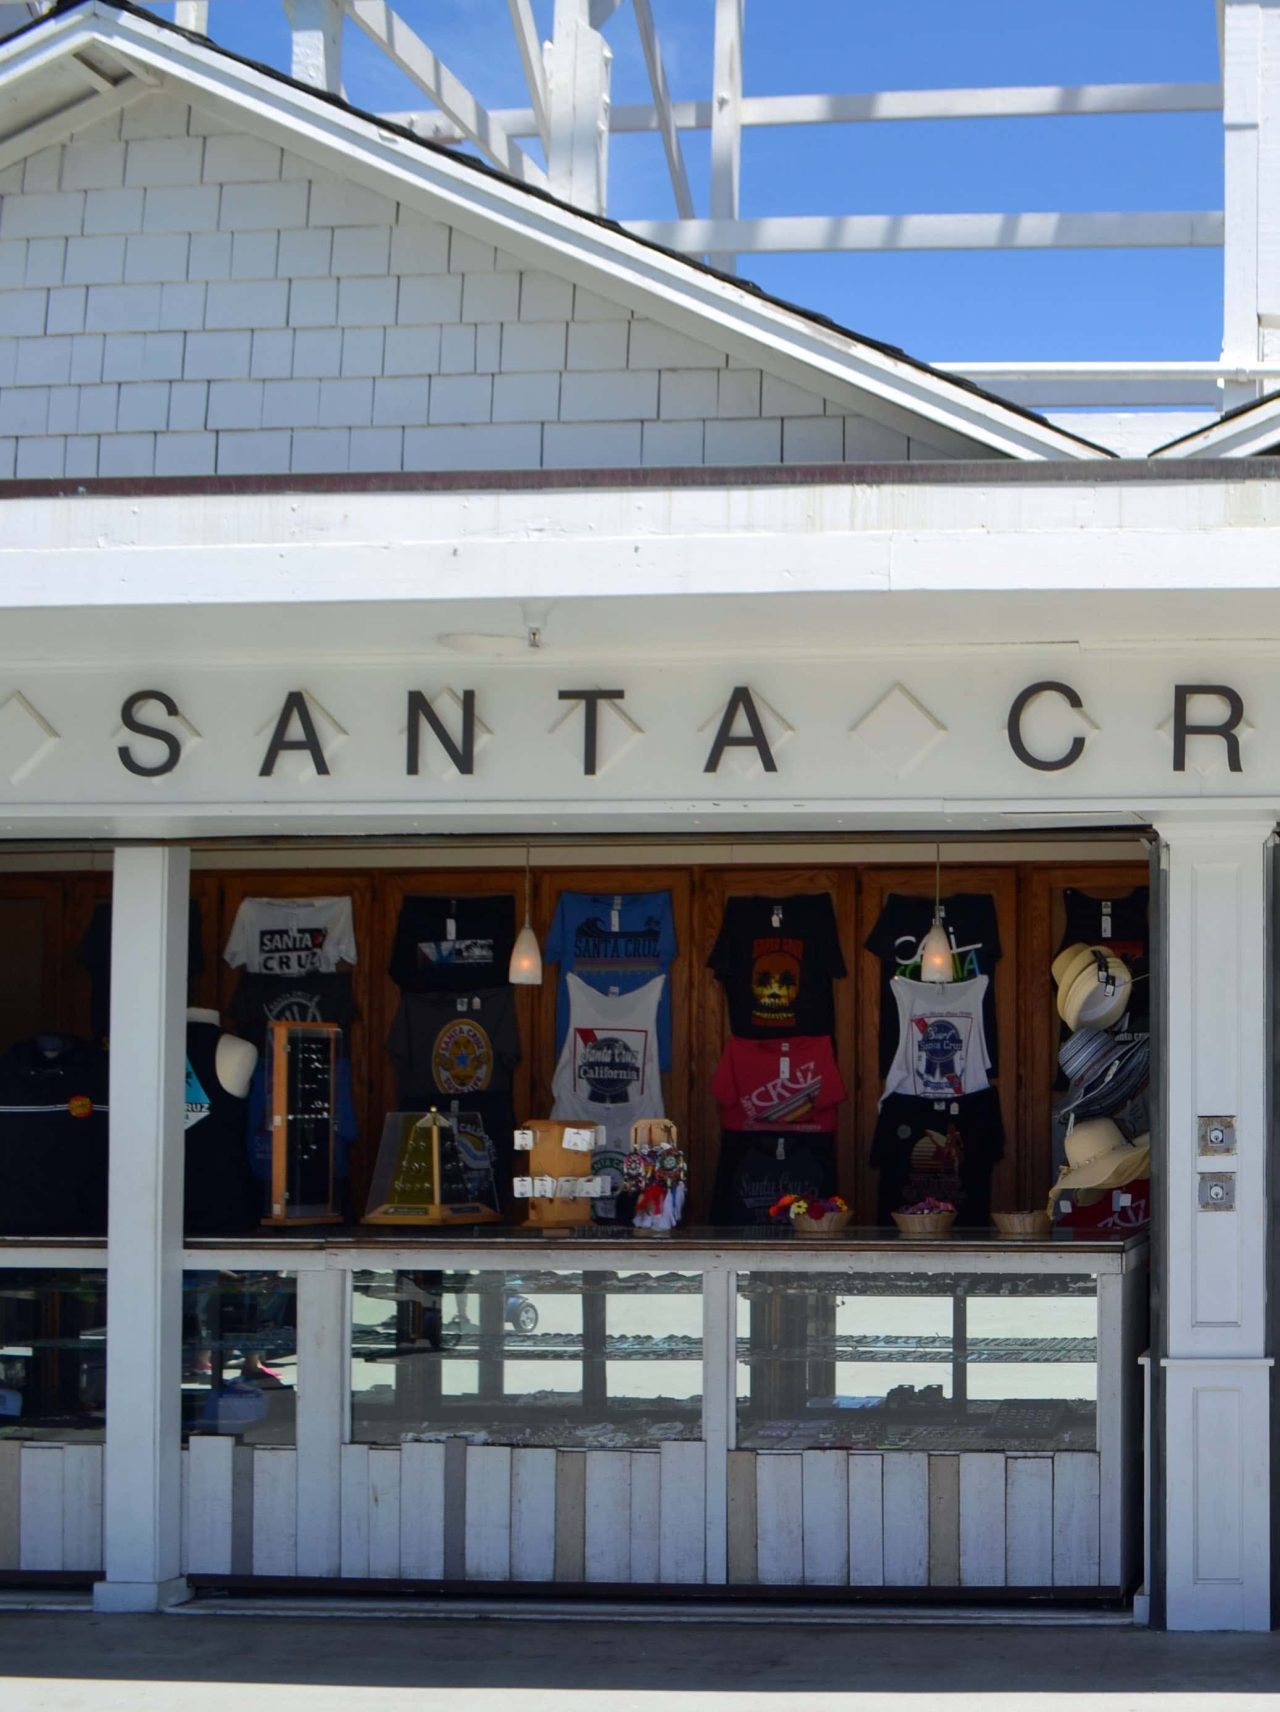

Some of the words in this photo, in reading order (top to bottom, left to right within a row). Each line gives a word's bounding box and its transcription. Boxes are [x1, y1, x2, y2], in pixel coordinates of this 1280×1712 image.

[118, 686, 778, 778] SANTA
[262, 932, 312, 951] SANTA
[575, 938, 621, 958] SANTA
[623, 938, 660, 957] CRUZ
[262, 951, 320, 971] CRUZ
[580, 1065, 638, 1081] California
[750, 1061, 823, 1107] CRUZ
